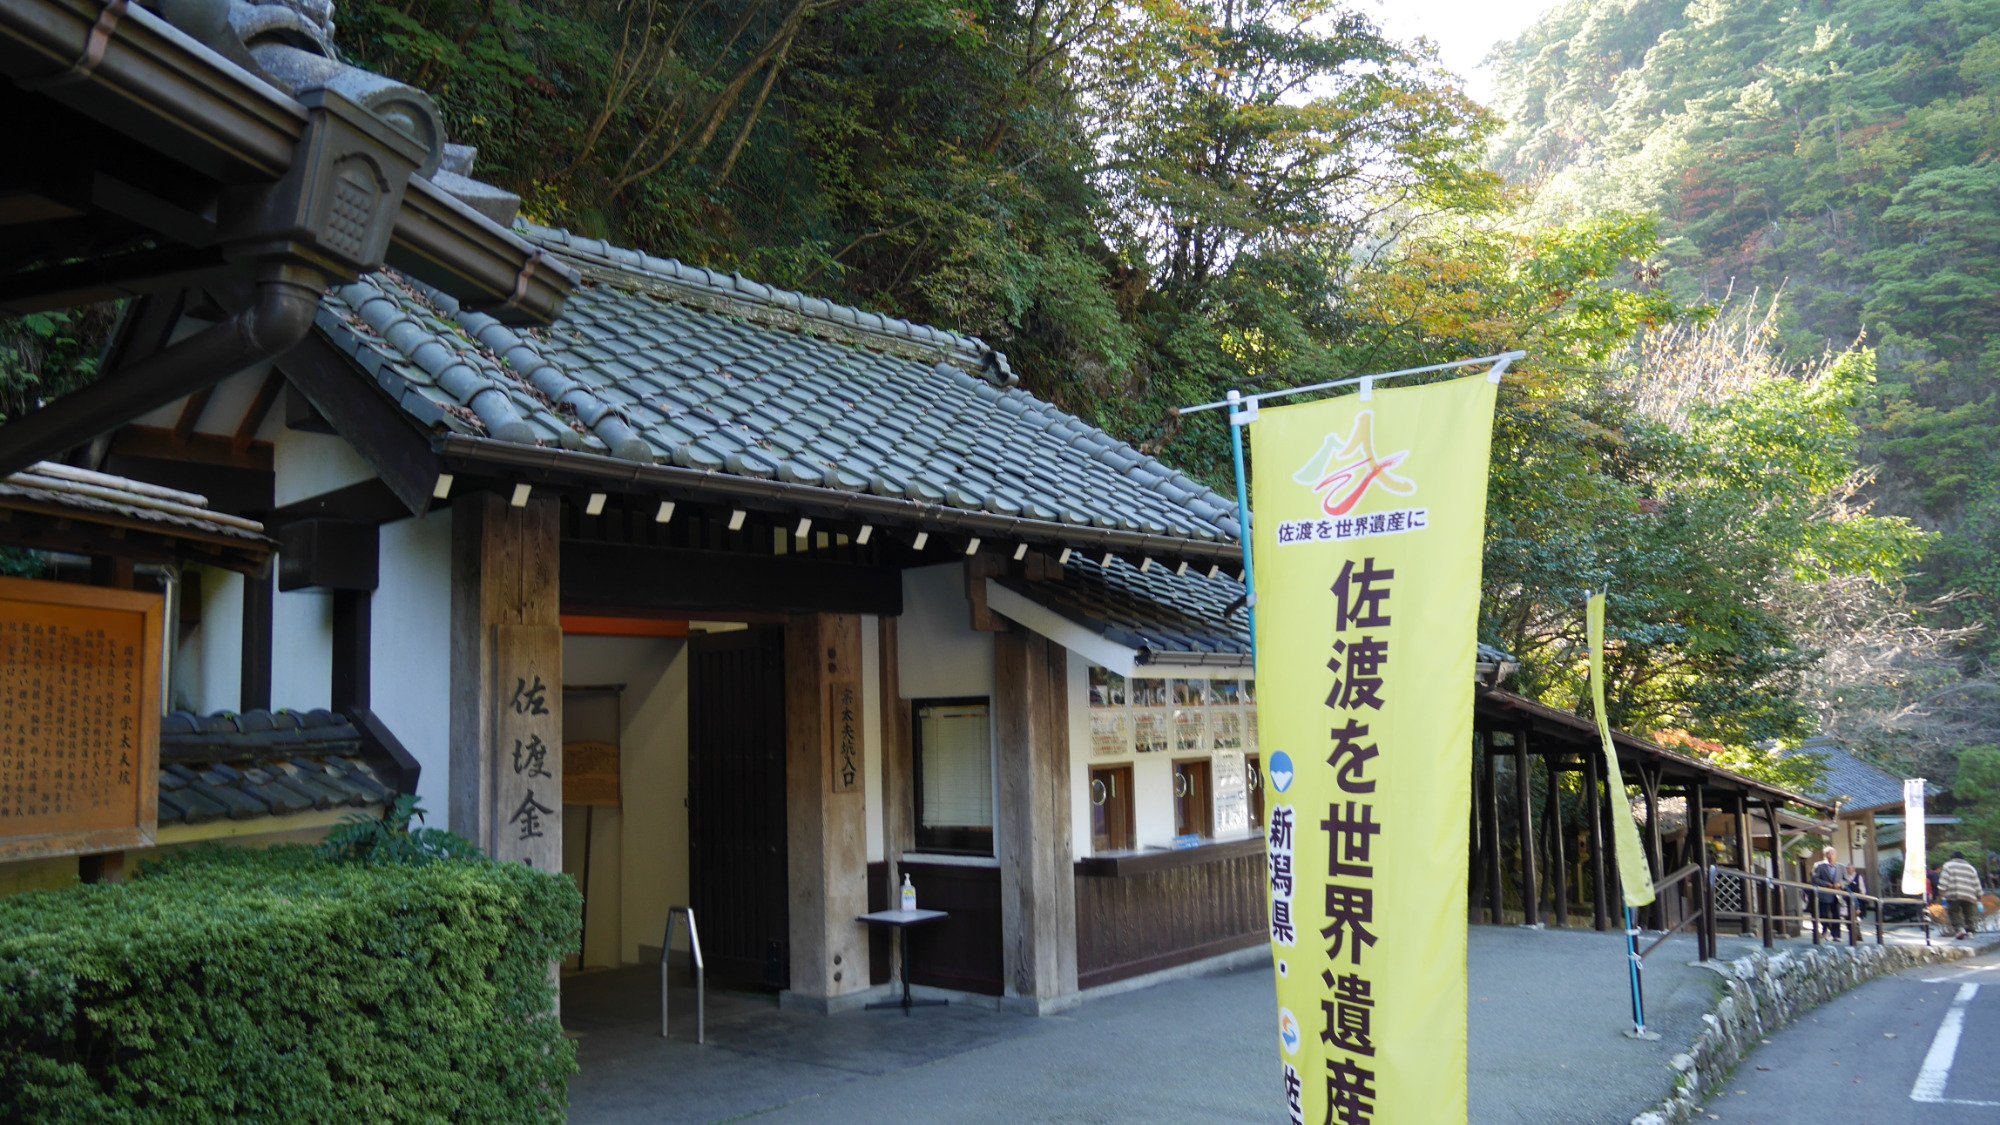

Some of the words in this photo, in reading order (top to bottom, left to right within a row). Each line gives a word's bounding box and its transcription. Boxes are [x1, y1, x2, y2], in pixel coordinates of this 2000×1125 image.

[1279, 511, 1425, 543] 佐渡を世界遺産に
[119, 715, 132, 785] 宗太夫坑
[509, 675, 553, 866] 佐渡金
[841, 689, 856, 787] 宗太夫坑入口
